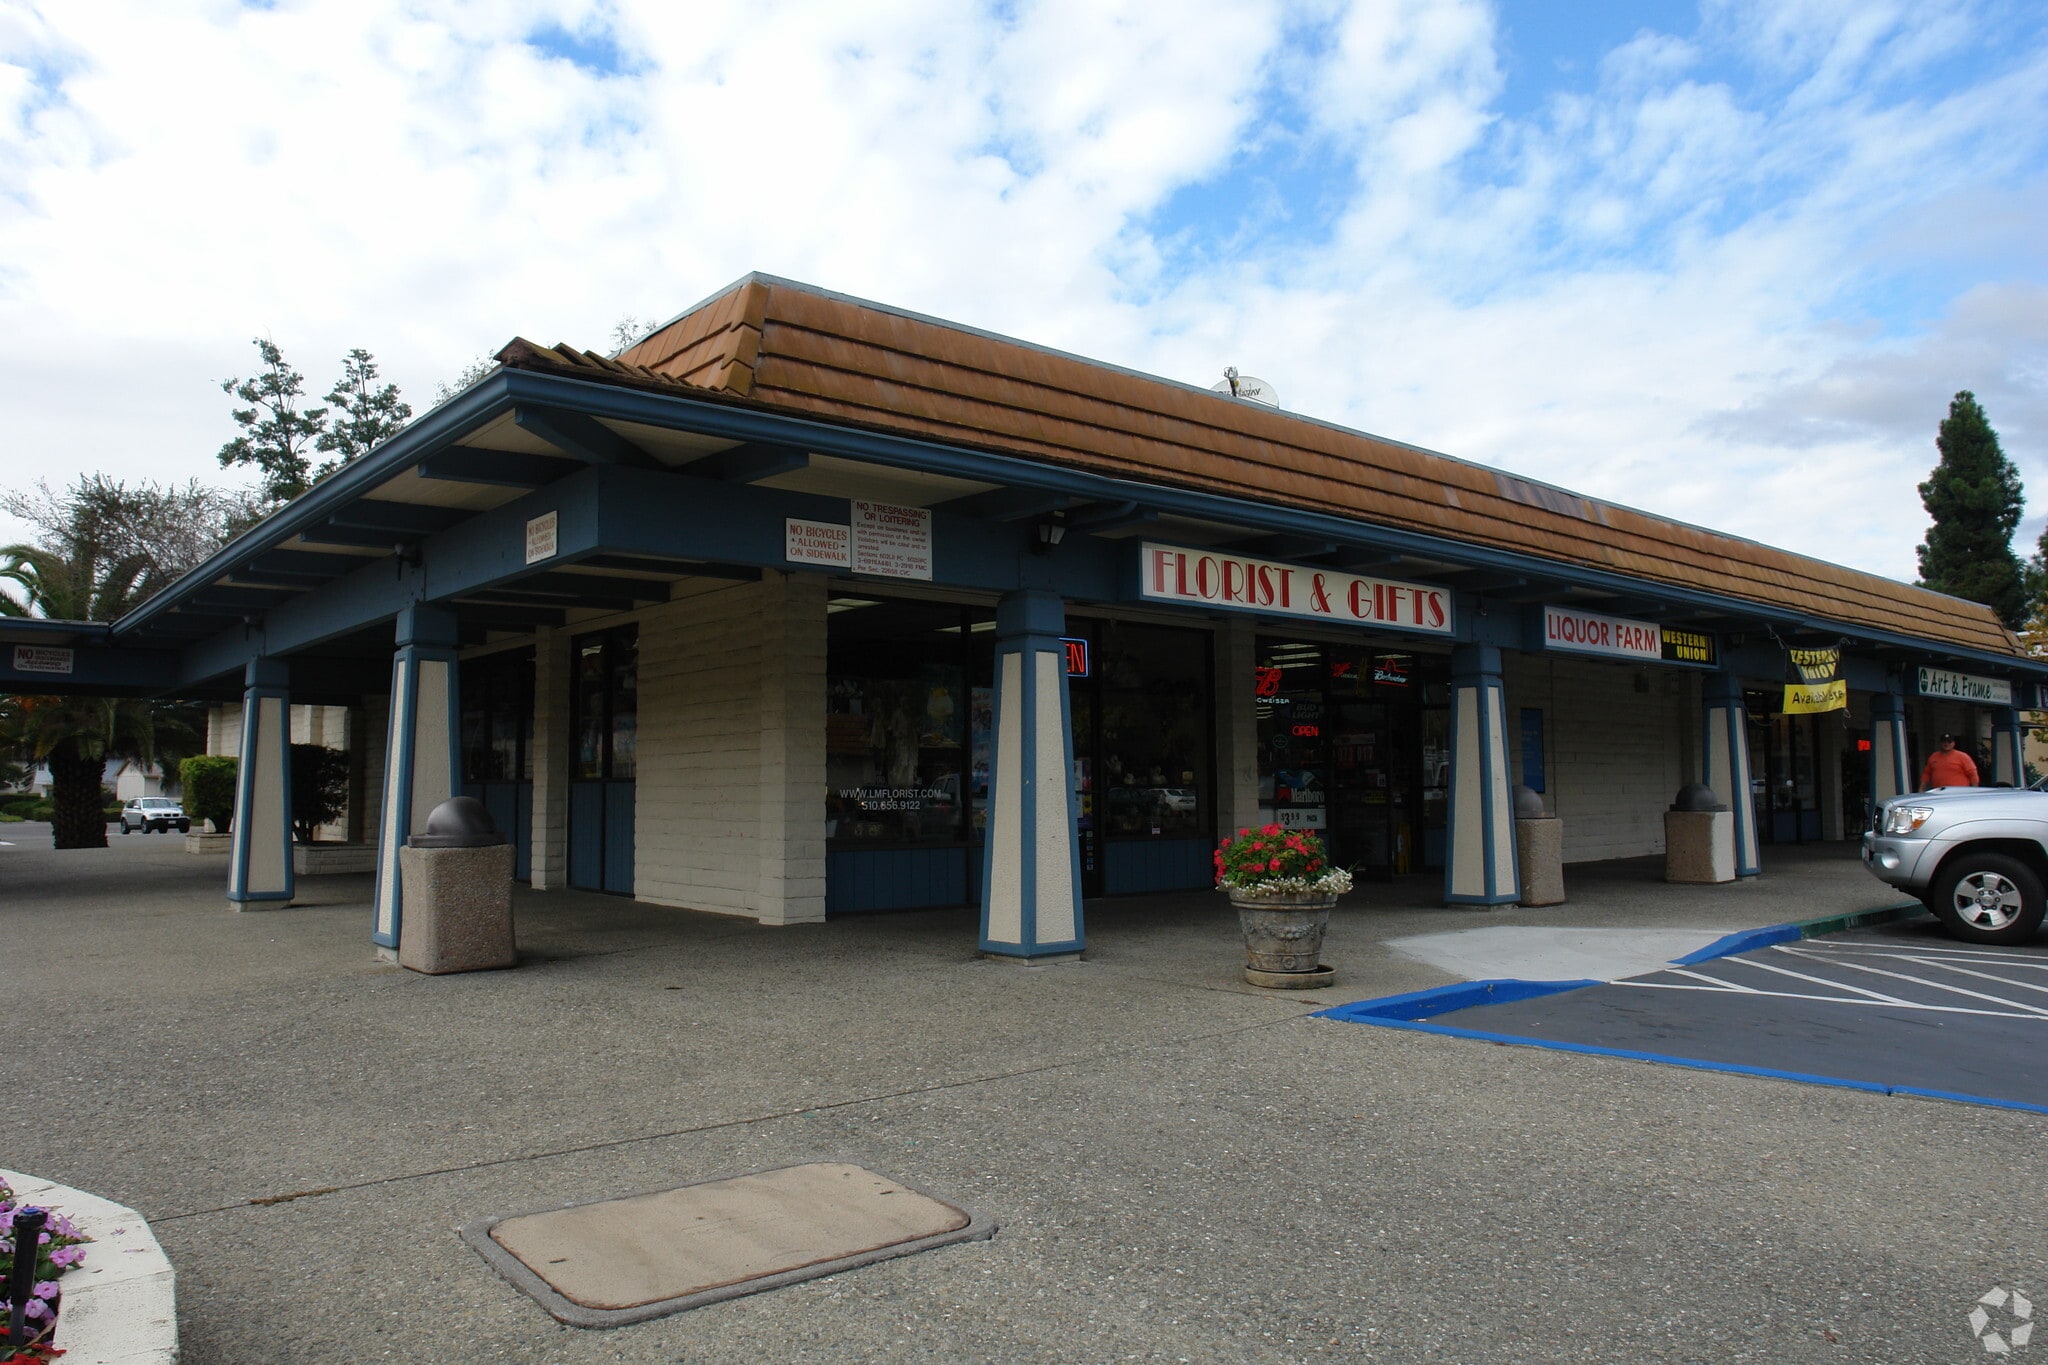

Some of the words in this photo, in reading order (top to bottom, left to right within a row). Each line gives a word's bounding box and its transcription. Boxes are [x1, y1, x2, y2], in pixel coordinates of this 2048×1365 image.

[857, 502, 869, 511] NO
[873, 504, 926, 520] TRESPASSING
[864, 512, 876, 521] OR
[880, 514, 920, 527] LOITERING
[790, 524, 803, 536] NO
[806, 527, 847, 541] BICYCLES
[798, 538, 839, 550] ALLOWED
[790, 548, 803, 557] ON
[807, 549, 847, 561] SIDEWALK
[1153, 549, 1295, 608] FLORIST
[1310, 573, 1331, 613] &
[1347, 579, 1445, 628] GIFTS
[1548, 614, 1610, 647] LIQUOR
[1616, 624, 1657, 653] FARM
[1662, 629, 1706, 648] WESTERN
[18, 648, 34, 660] NO
[1676, 645, 1707, 662] UNION
[1930, 671, 1949, 693] Art
[1951, 674, 1959, 696] &
[1962, 676, 1992, 699] Frame
[1296, 703, 1317, 712] BUD
[1292, 711, 1319, 720] LIGHT
[1292, 725, 1319, 737] OPEN
[839, 788, 942, 799] WWW.LMFLORIST.COM
[1291, 787, 1325, 803] Marlboro
[861, 800, 921, 810] 510.656.9122
